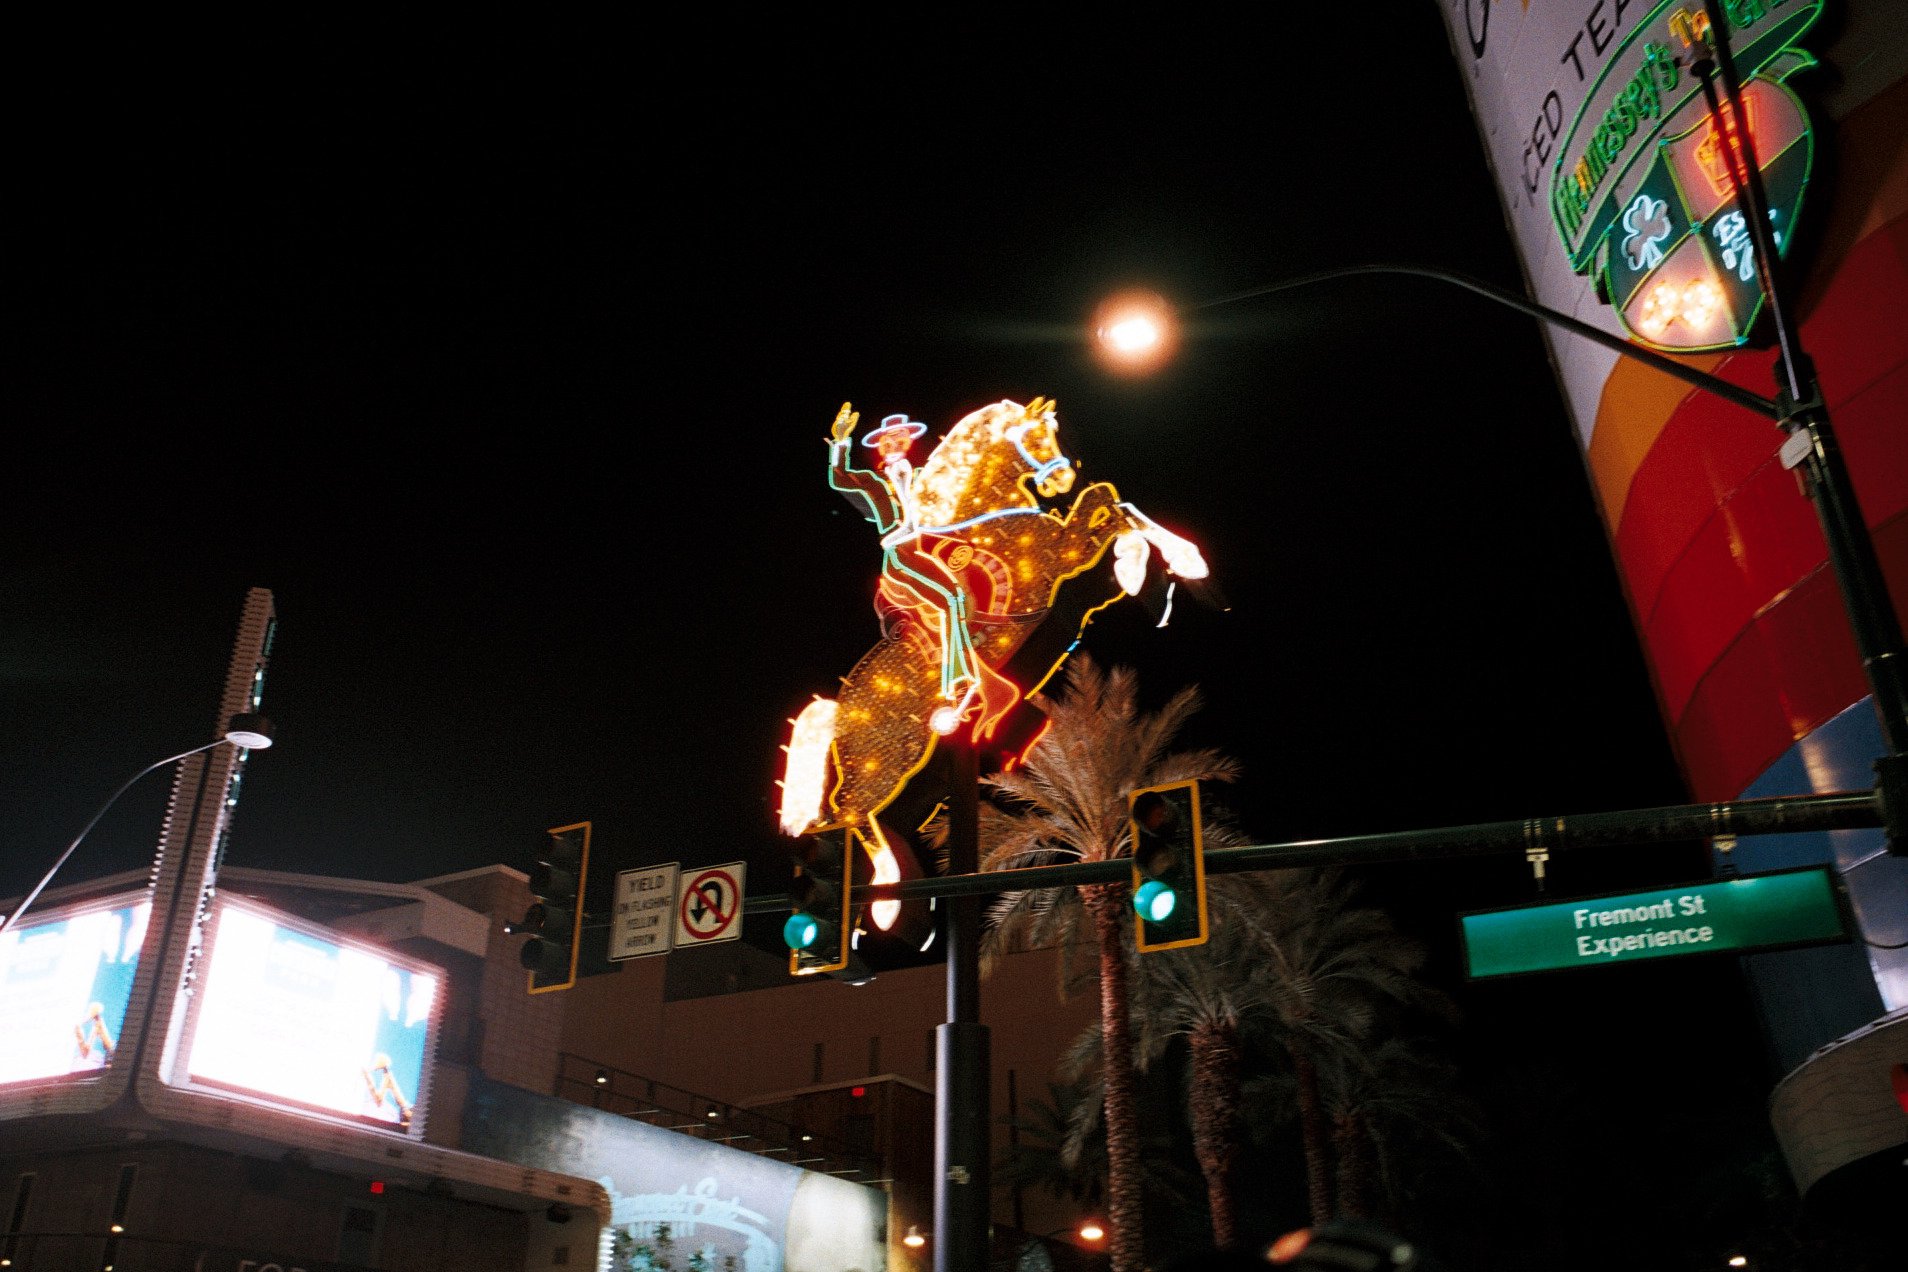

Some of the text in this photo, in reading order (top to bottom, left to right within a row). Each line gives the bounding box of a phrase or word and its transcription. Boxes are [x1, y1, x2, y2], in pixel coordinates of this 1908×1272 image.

[628, 875, 666, 893] YIELD
[1573, 895, 1707, 929] Fremont St
[625, 915, 659, 930] YELLOW
[624, 934, 656, 947] ARROW
[1576, 926, 1714, 957] Experience
